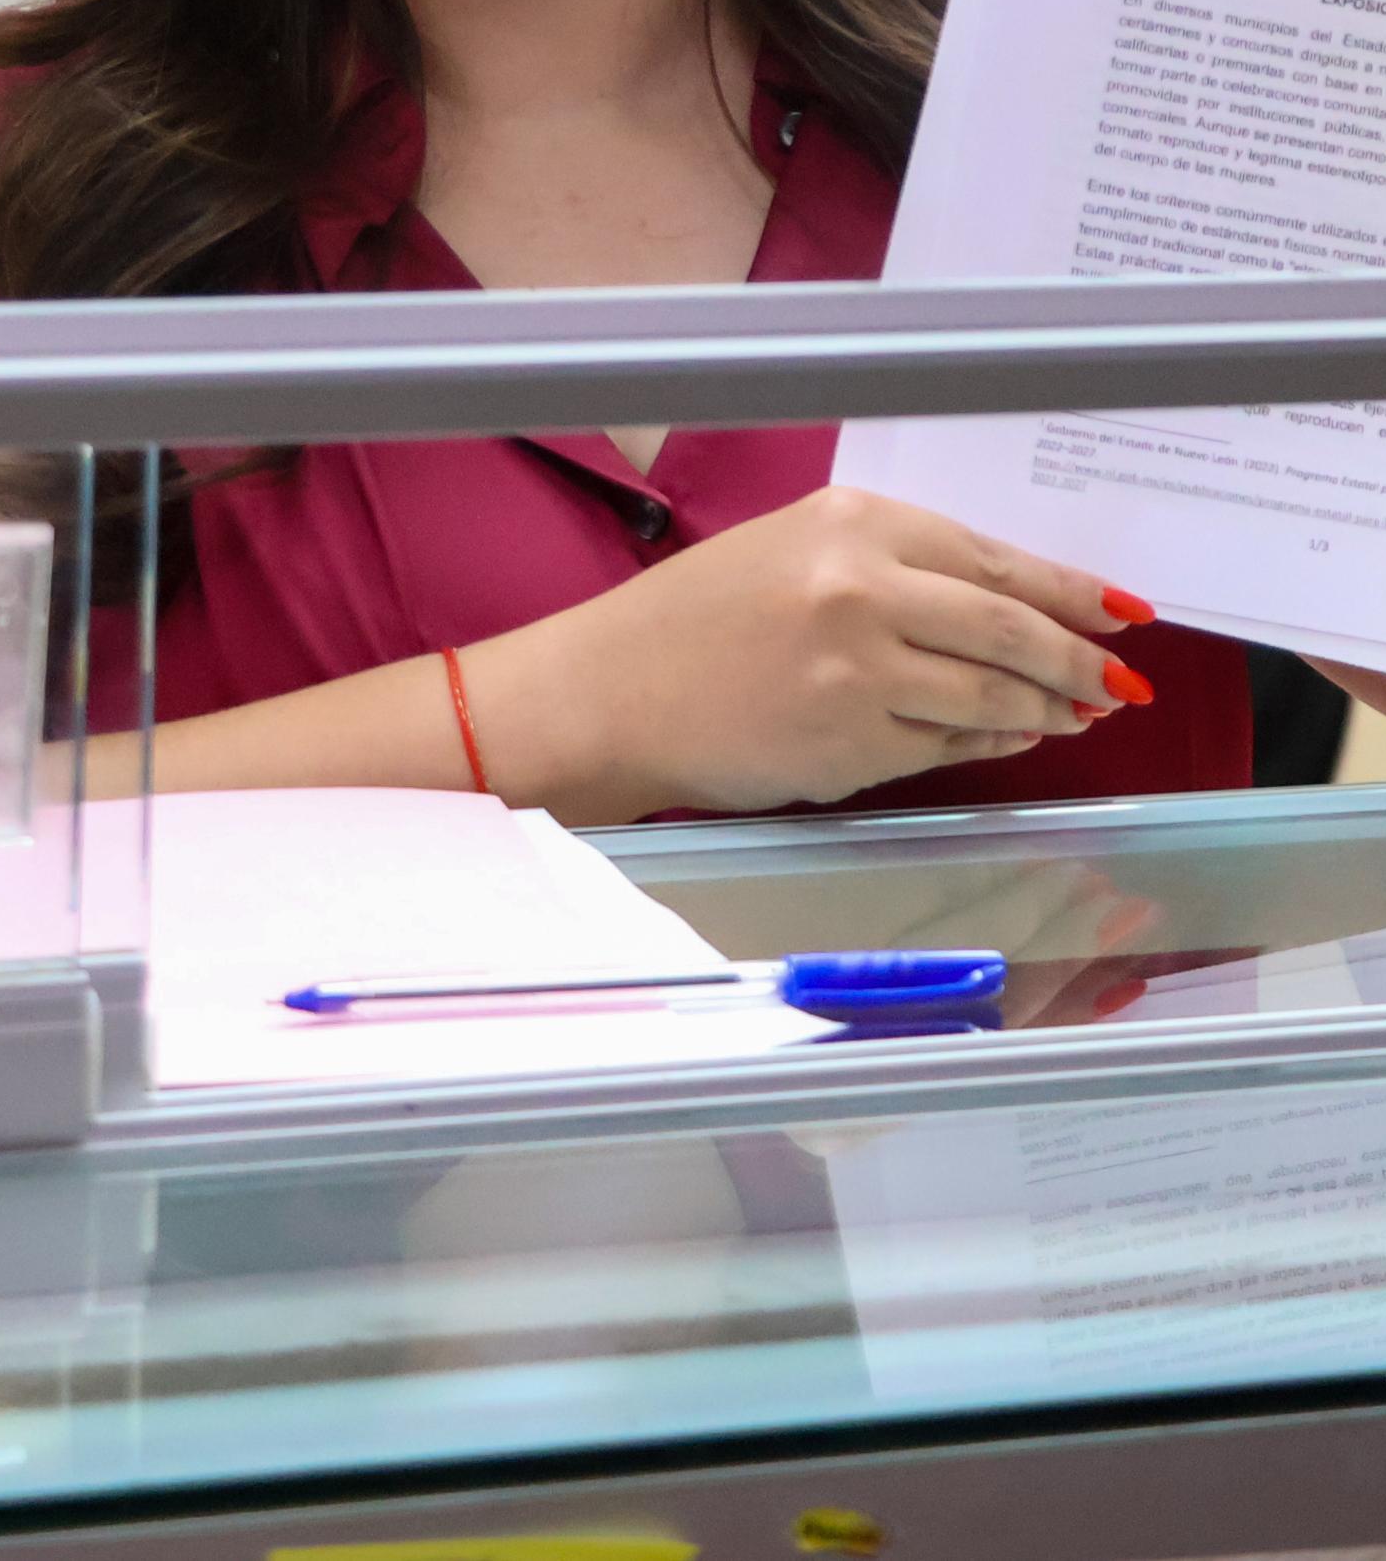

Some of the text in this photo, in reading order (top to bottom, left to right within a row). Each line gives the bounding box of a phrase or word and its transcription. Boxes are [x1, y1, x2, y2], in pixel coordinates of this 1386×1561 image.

[1224, 13, 1299, 37] municipios
[1309, 28, 1332, 44] del
[1109, 55, 1156, 76] formar
[1159, 67, 1196, 84] parte
[1200, 74, 1218, 88] de
[1221, 79, 1319, 108] celebraciones
[1113, 37, 1189, 61] calificarlas
[1210, 54, 1285, 79] premiarlas
[1291, 70, 1317, 86] con
[1323, 73, 1358, 93] base
[1364, 84, 1382, 96] en
[1105, 79, 1188, 105] promovidas
[1196, 96, 1220, 110] por
[1228, 101, 1315, 129] instituciones
[1244, 402, 1269, 416] que
[1284, 410, 1364, 434] reproducen
